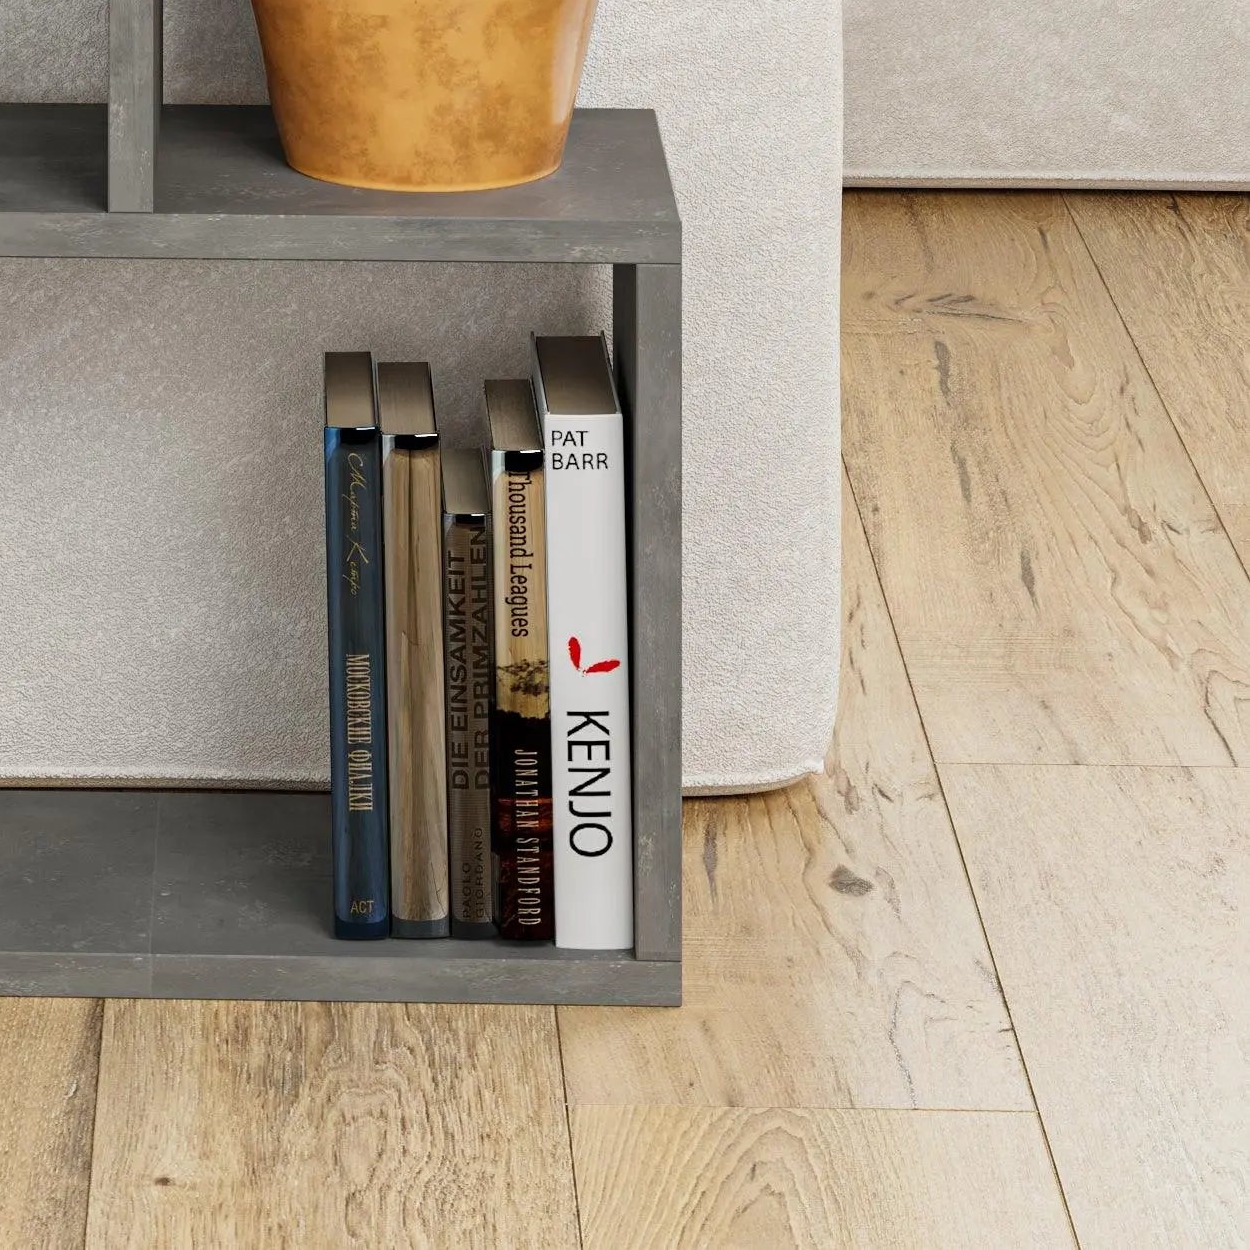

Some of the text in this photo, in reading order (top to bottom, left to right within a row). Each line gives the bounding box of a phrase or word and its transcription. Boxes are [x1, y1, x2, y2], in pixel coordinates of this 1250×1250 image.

[551, 430, 588, 447] PAT
[551, 453, 608, 470] BARR
[505, 472, 534, 637] Thousand Leagues
[448, 551, 470, 790] DIE EINSAMKEIT
[470, 526, 491, 790] DER PRIMZAHLEN
[514, 749, 542, 926] JONATHAN STANDFORD
[566, 710, 613, 857] KENJO
[461, 862, 472, 918] PAOLO
[473, 828, 485, 919] GIORDANO
